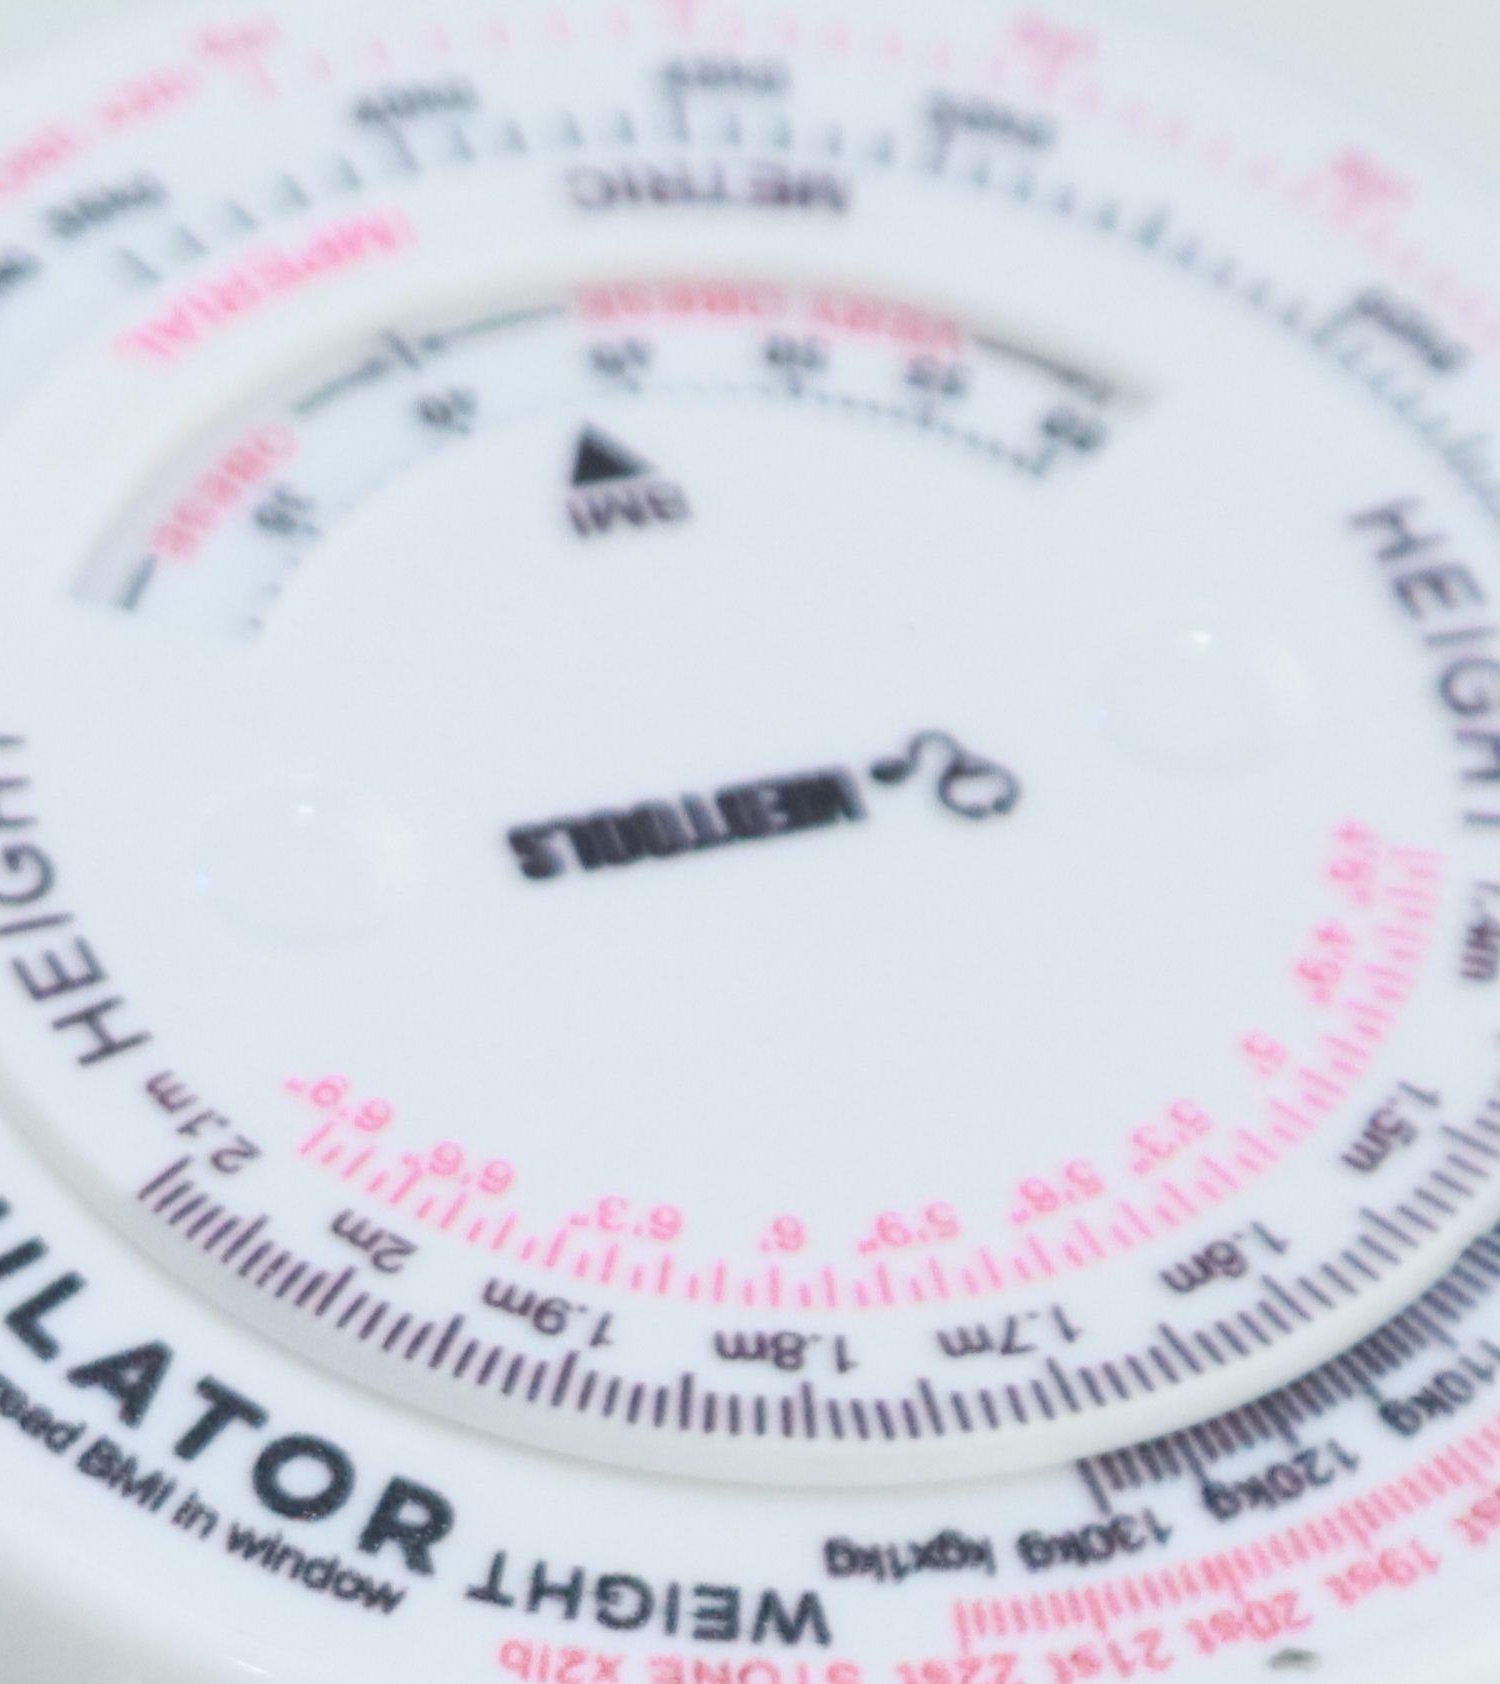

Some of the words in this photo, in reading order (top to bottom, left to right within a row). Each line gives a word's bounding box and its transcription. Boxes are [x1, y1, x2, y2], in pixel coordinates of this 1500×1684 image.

[568, 167, 850, 213] METRIC
[145, 1070, 262, 1176] 2.1m
[1342, 1082, 1440, 1176] 1.5m
[332, 1212, 417, 1273] 2m
[1160, 1222, 1288, 1295] 1.6m
[483, 1275, 616, 1350] 1.9m
[938, 1305, 1080, 1358] 1.7m
[715, 1329, 860, 1374] 1.8m
[1201, 1436, 1361, 1522] 120kg
[77, 1434, 178, 1510] BMI
[173, 1488, 220, 1541] in
[225, 1508, 408, 1617] window
[1016, 1509, 1172, 1572] 130kg
[466, 1550, 833, 1648] WEIGHT
[1326, 1539, 1441, 1608] 19st
[1187, 1588, 1312, 1659] 20st
